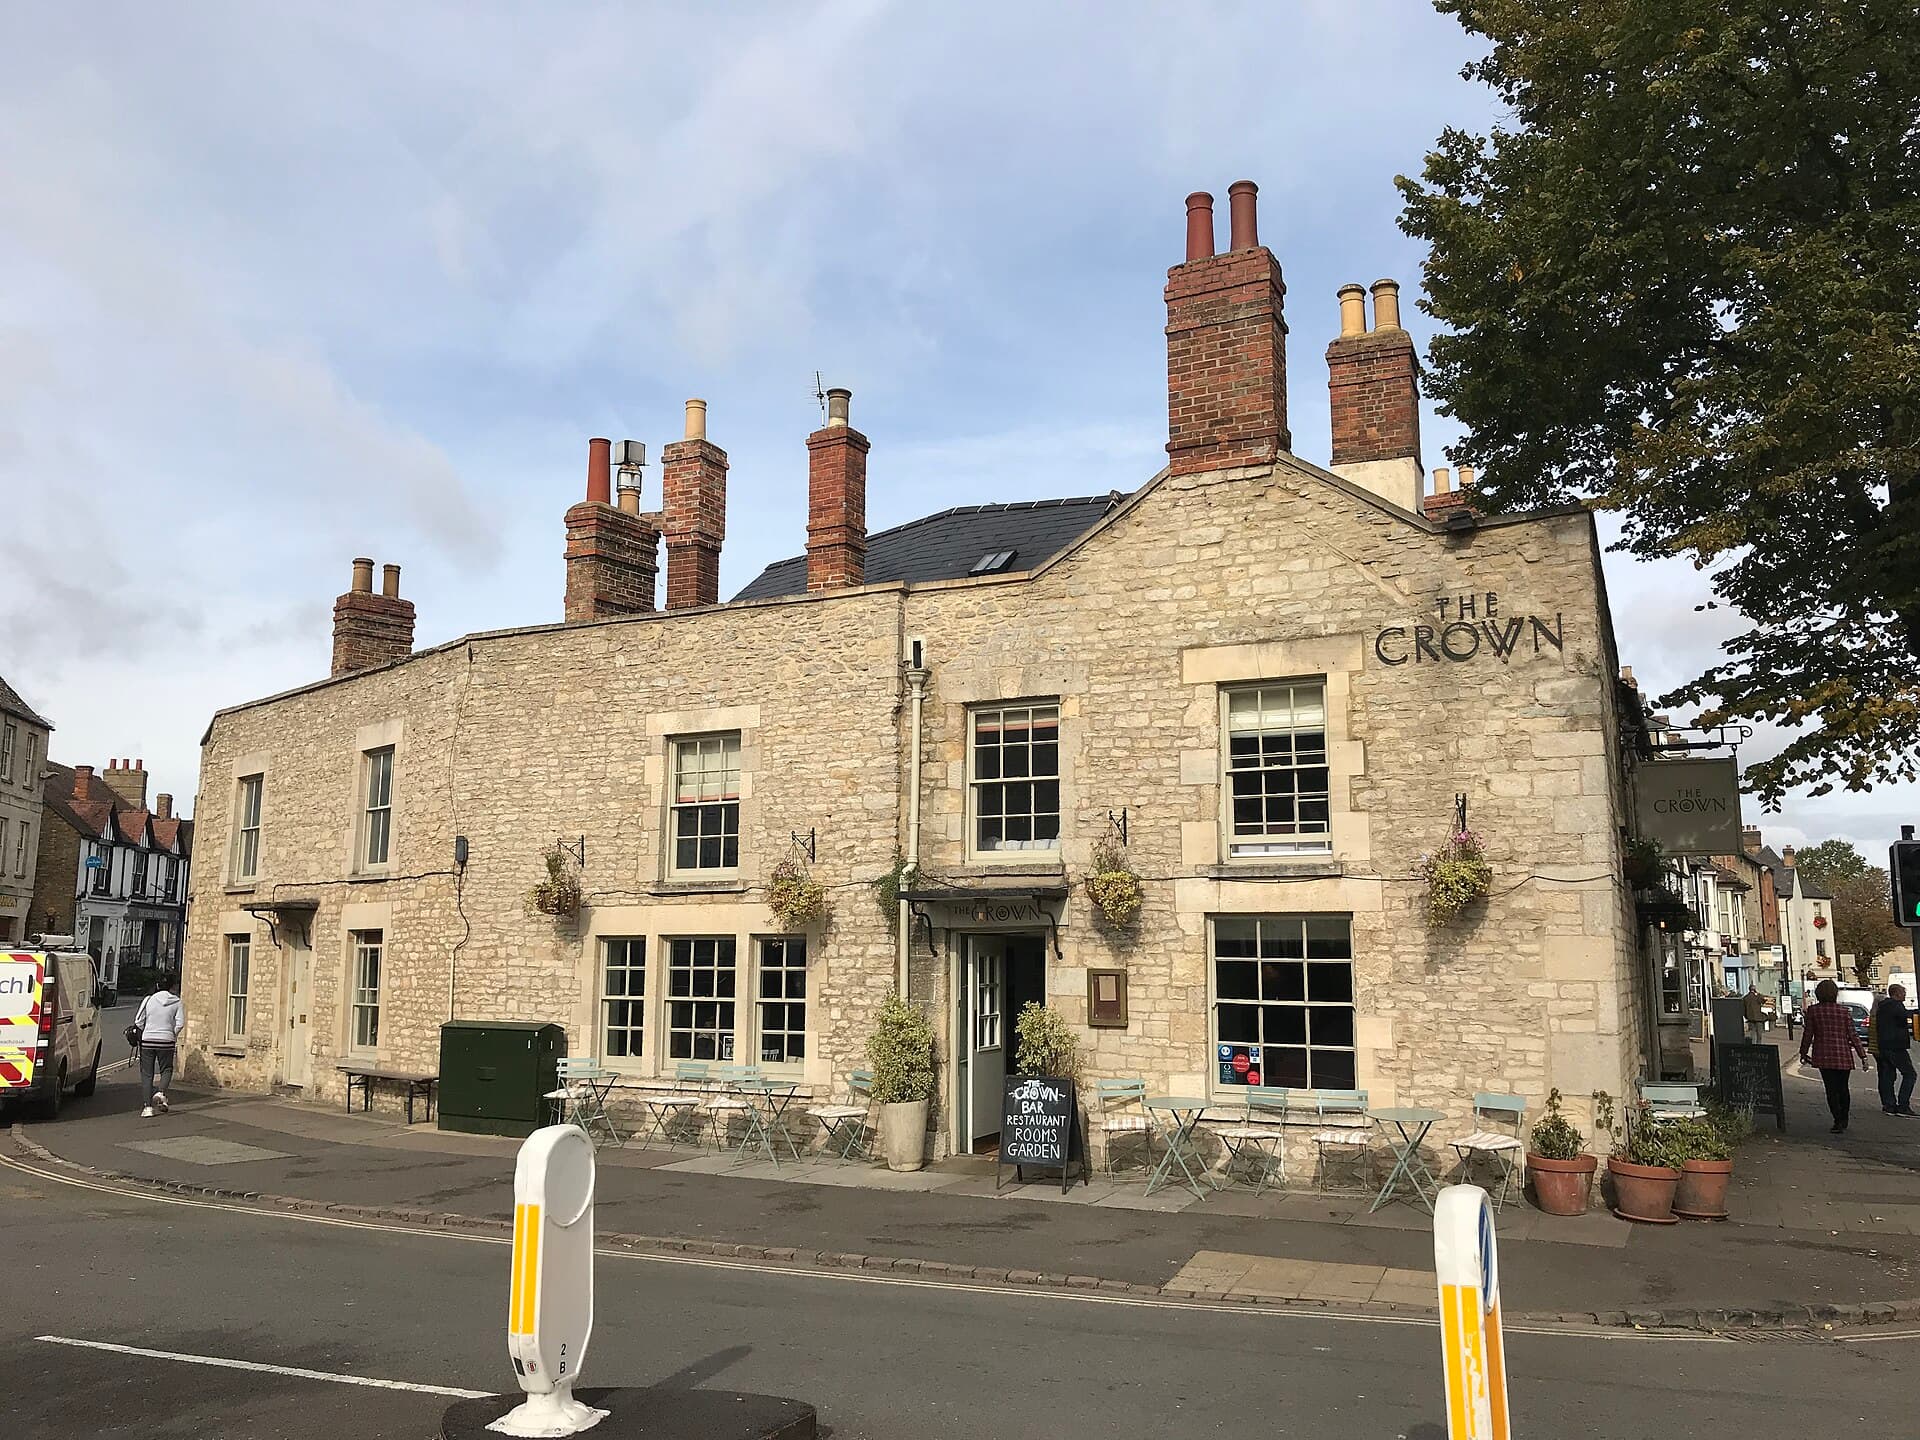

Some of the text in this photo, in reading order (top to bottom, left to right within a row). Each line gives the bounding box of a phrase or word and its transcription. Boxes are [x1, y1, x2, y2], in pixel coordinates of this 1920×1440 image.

[1435, 591, 1498, 621] THE
[1375, 612, 1563, 666] CROWN
[1677, 788, 1702, 798] THE
[1653, 798, 1726, 813] CROWN
[953, 904, 970, 915] THE
[1014, 1086, 1059, 1101] CROWN
[1021, 1101, 1045, 1114] BAR
[1007, 1114, 1067, 1127] RESTAURANT
[1015, 1127, 1058, 1142] ROOMS
[1007, 1142, 1060, 1159] GARDEN
[560, 1343, 567, 1356] 2
[559, 1361, 566, 1374] B
